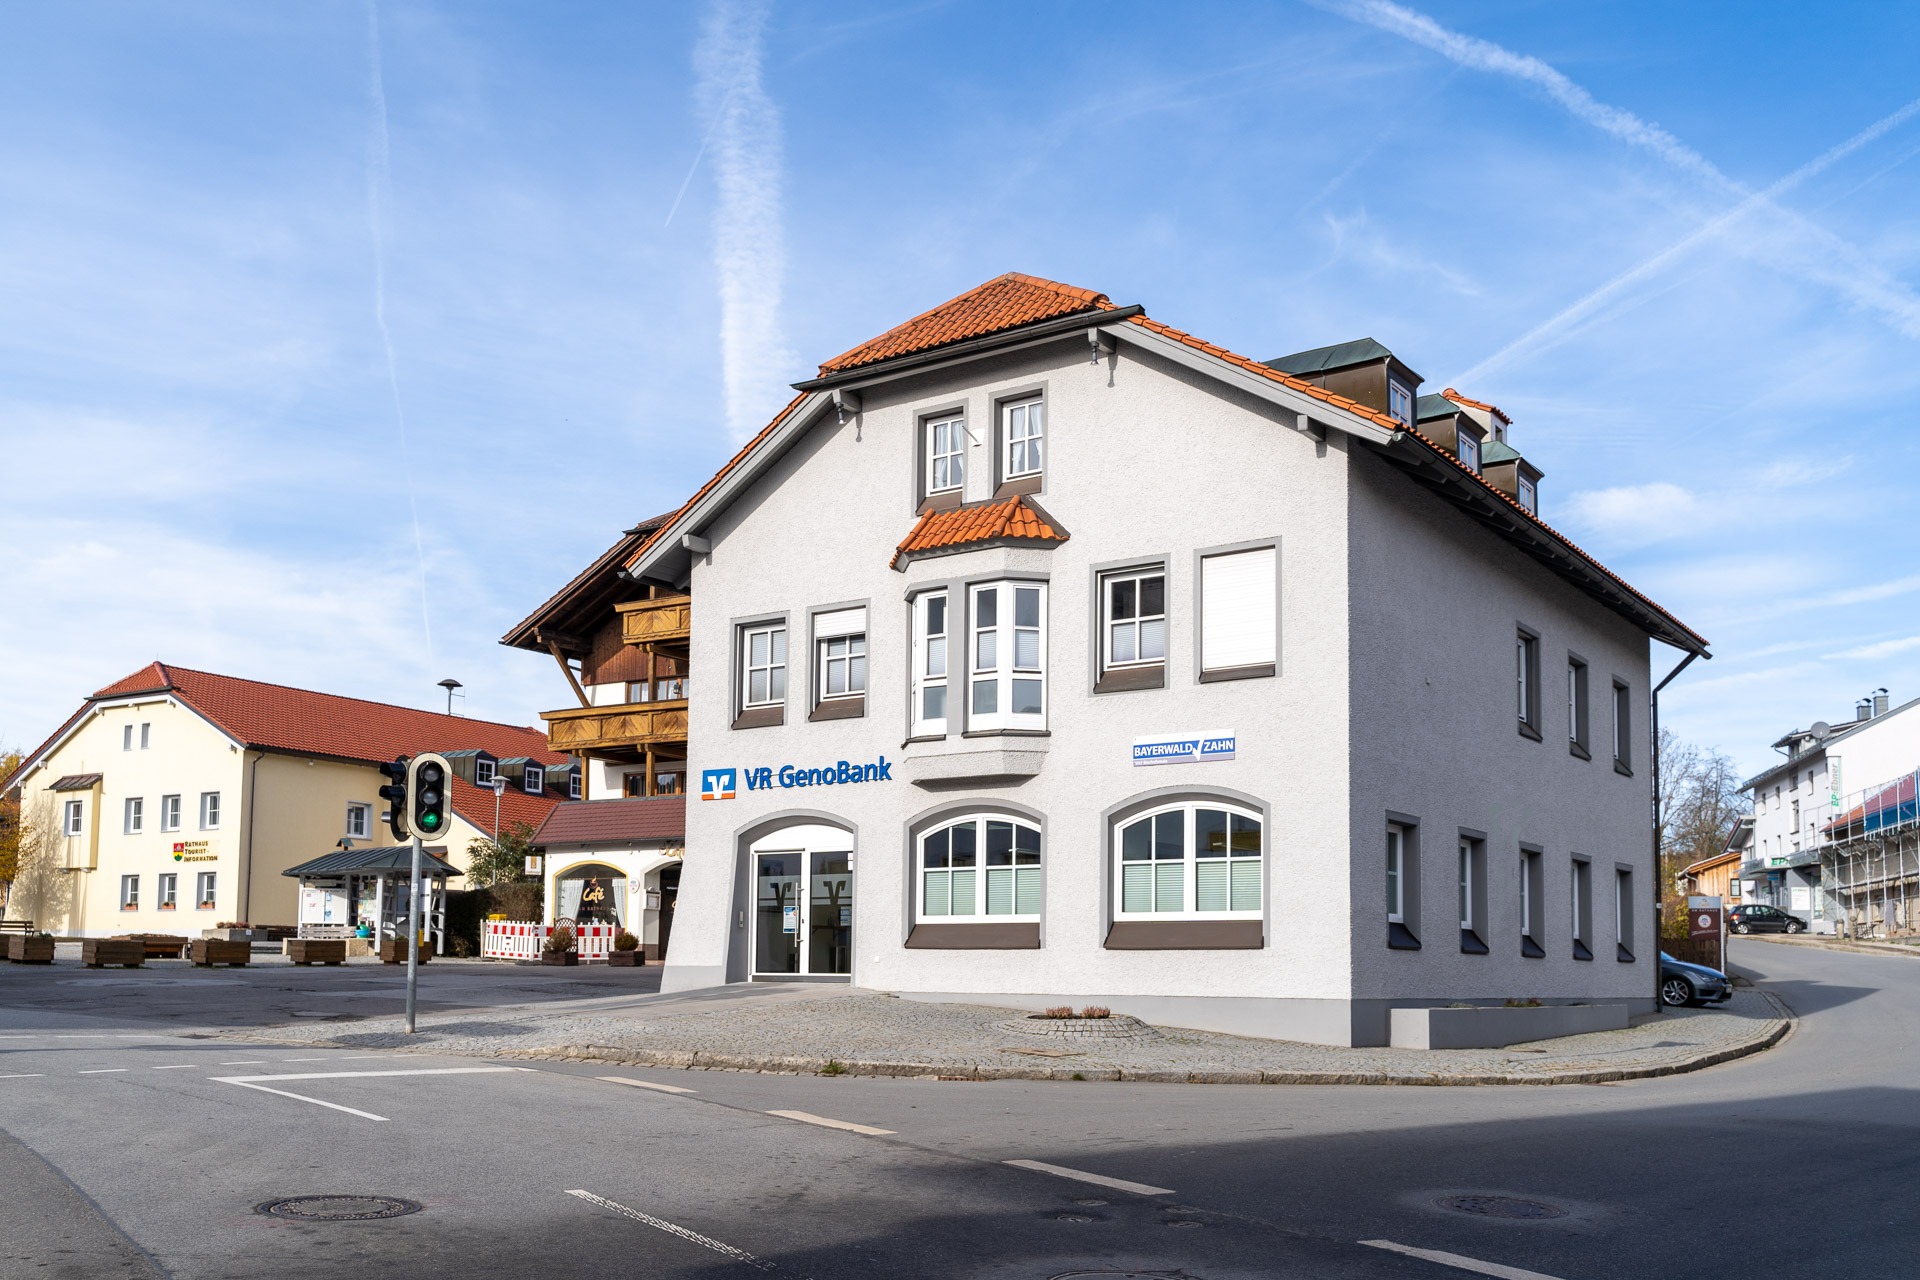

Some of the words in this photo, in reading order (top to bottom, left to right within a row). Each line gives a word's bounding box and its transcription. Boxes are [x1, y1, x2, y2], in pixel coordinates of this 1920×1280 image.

[1134, 743, 1193, 757] BAYERWALD
[1203, 740, 1234, 752] ZAHN
[744, 767, 773, 790] VR
[778, 755, 892, 788] GenoBank
[583, 886, 605, 903] Café
